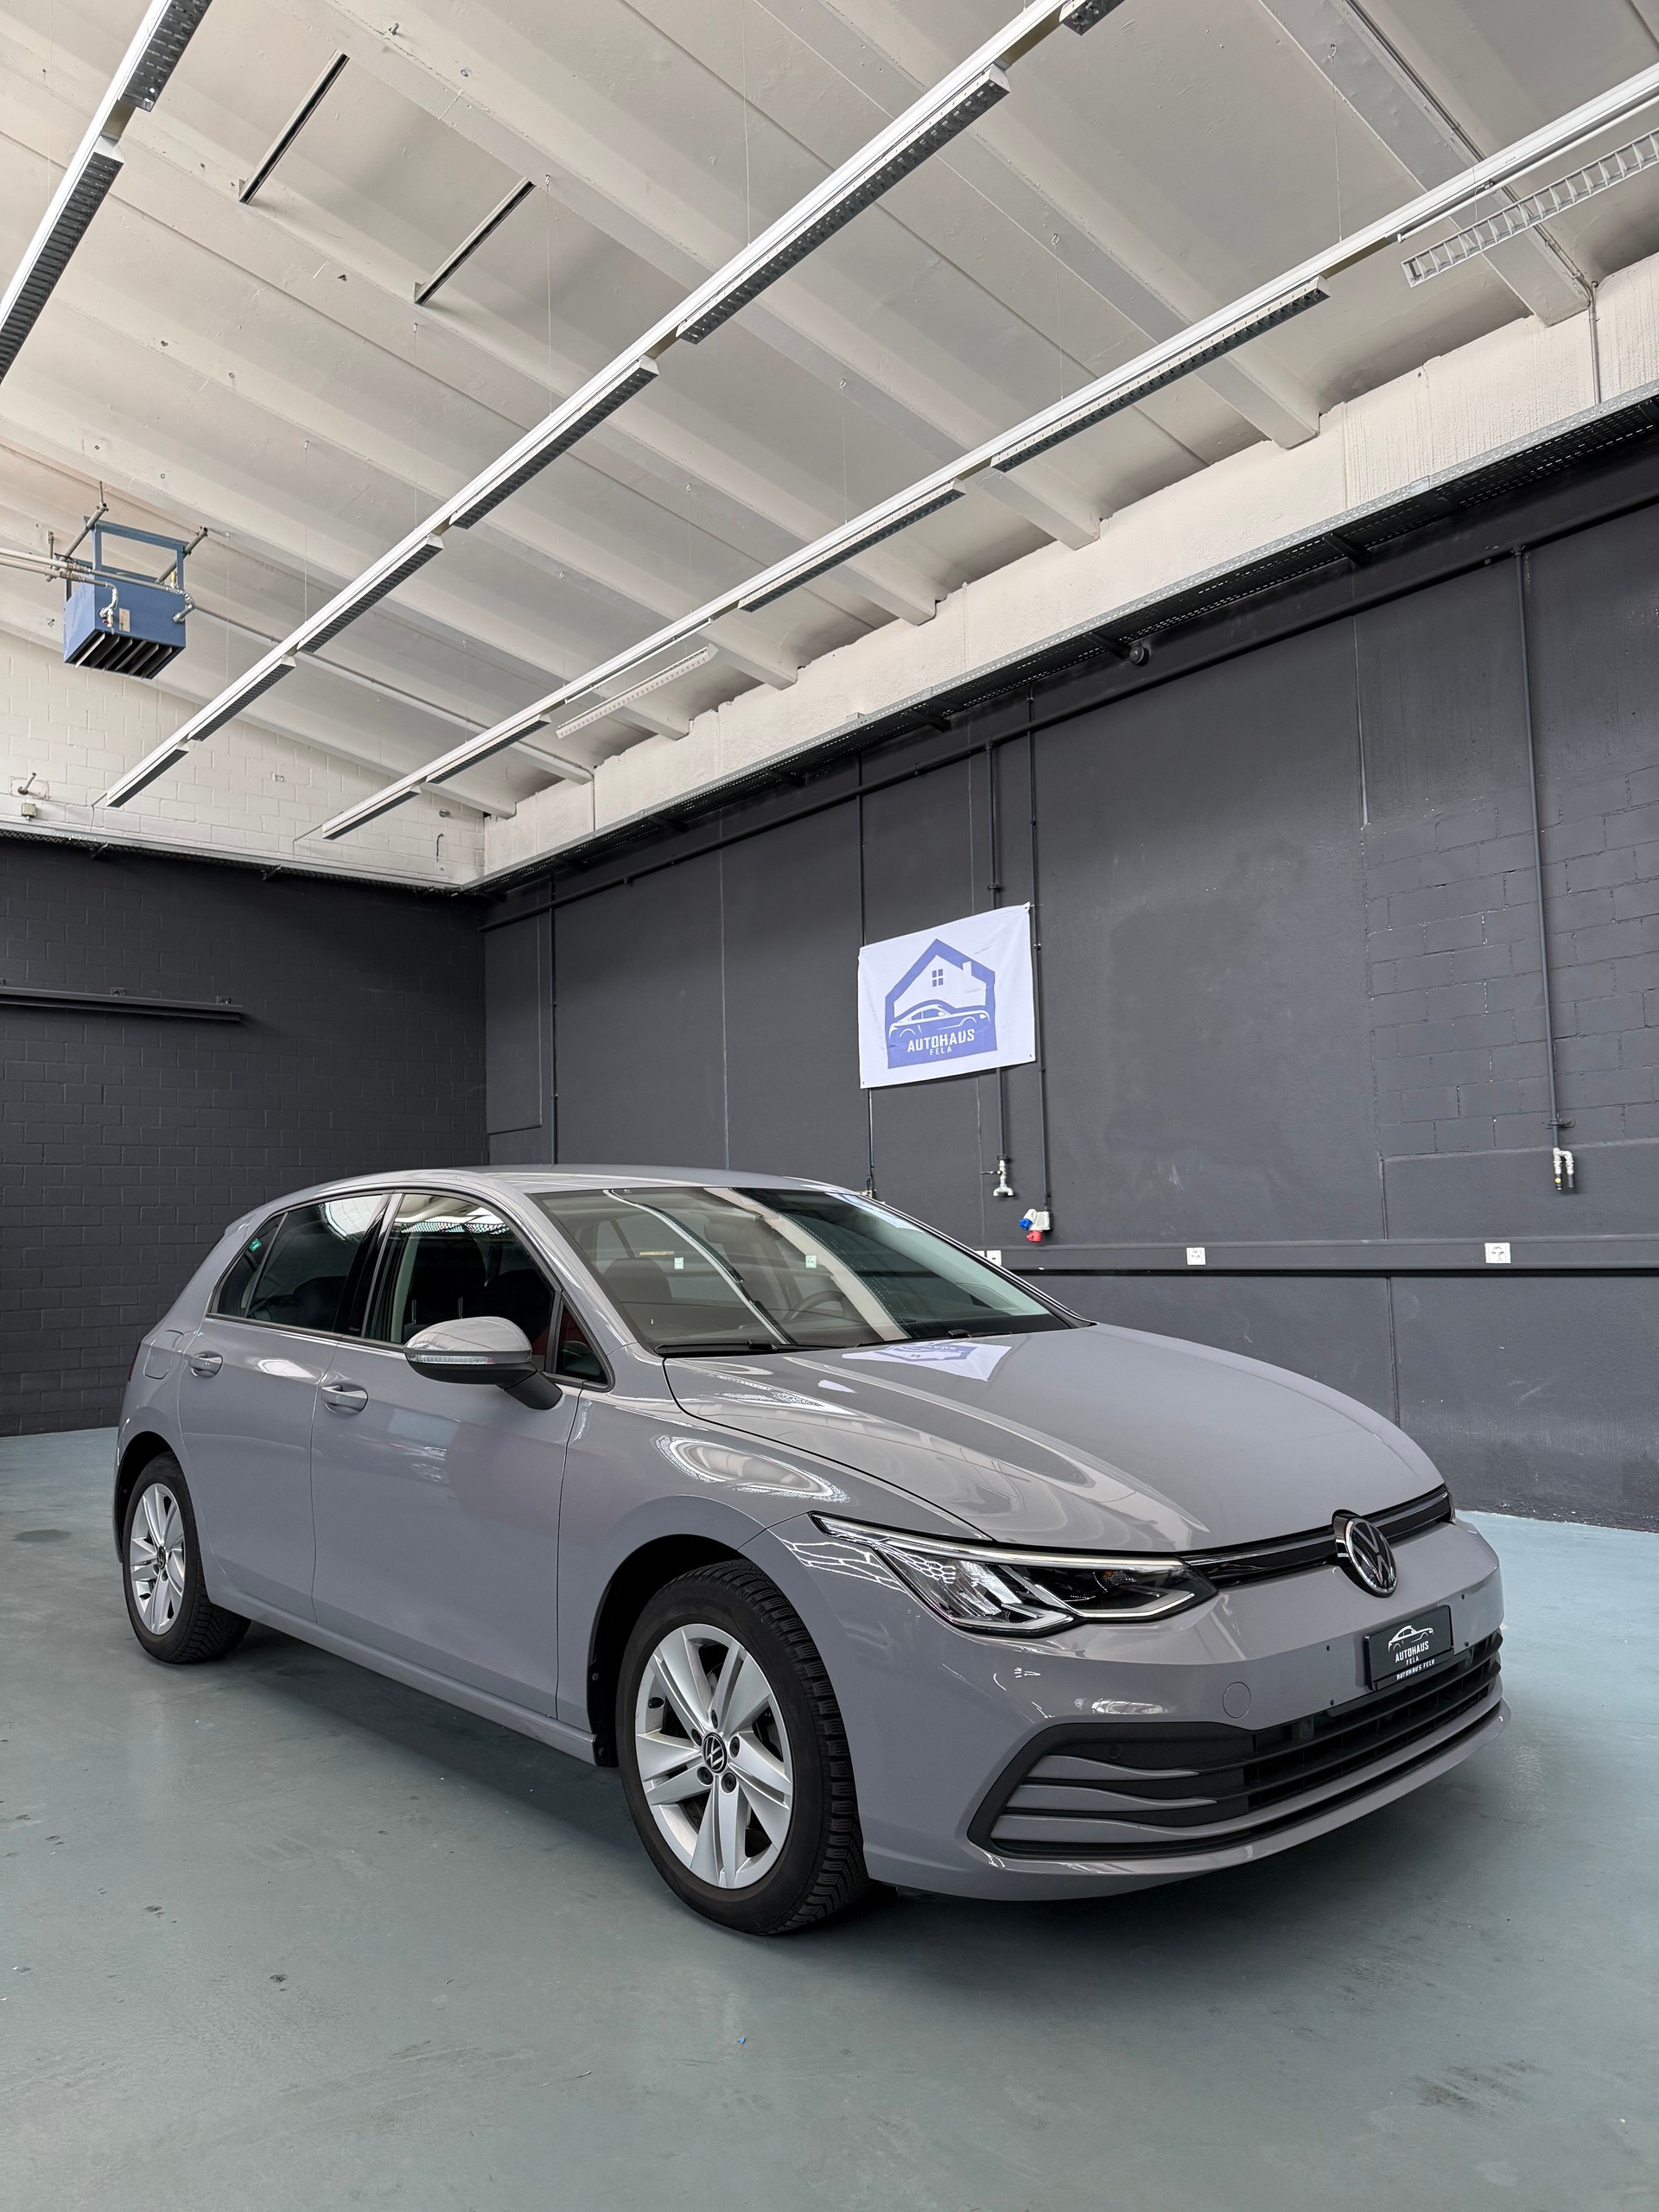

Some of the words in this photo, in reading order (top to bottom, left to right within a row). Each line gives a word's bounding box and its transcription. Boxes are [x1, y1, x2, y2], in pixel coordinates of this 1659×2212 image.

[907, 1028, 975, 1052] AUTOHAUS
[930, 1046, 952, 1056] FELA
[1395, 1641, 1429, 1662] AUTOHAUS
[1406, 1656, 1420, 1666] FELA
